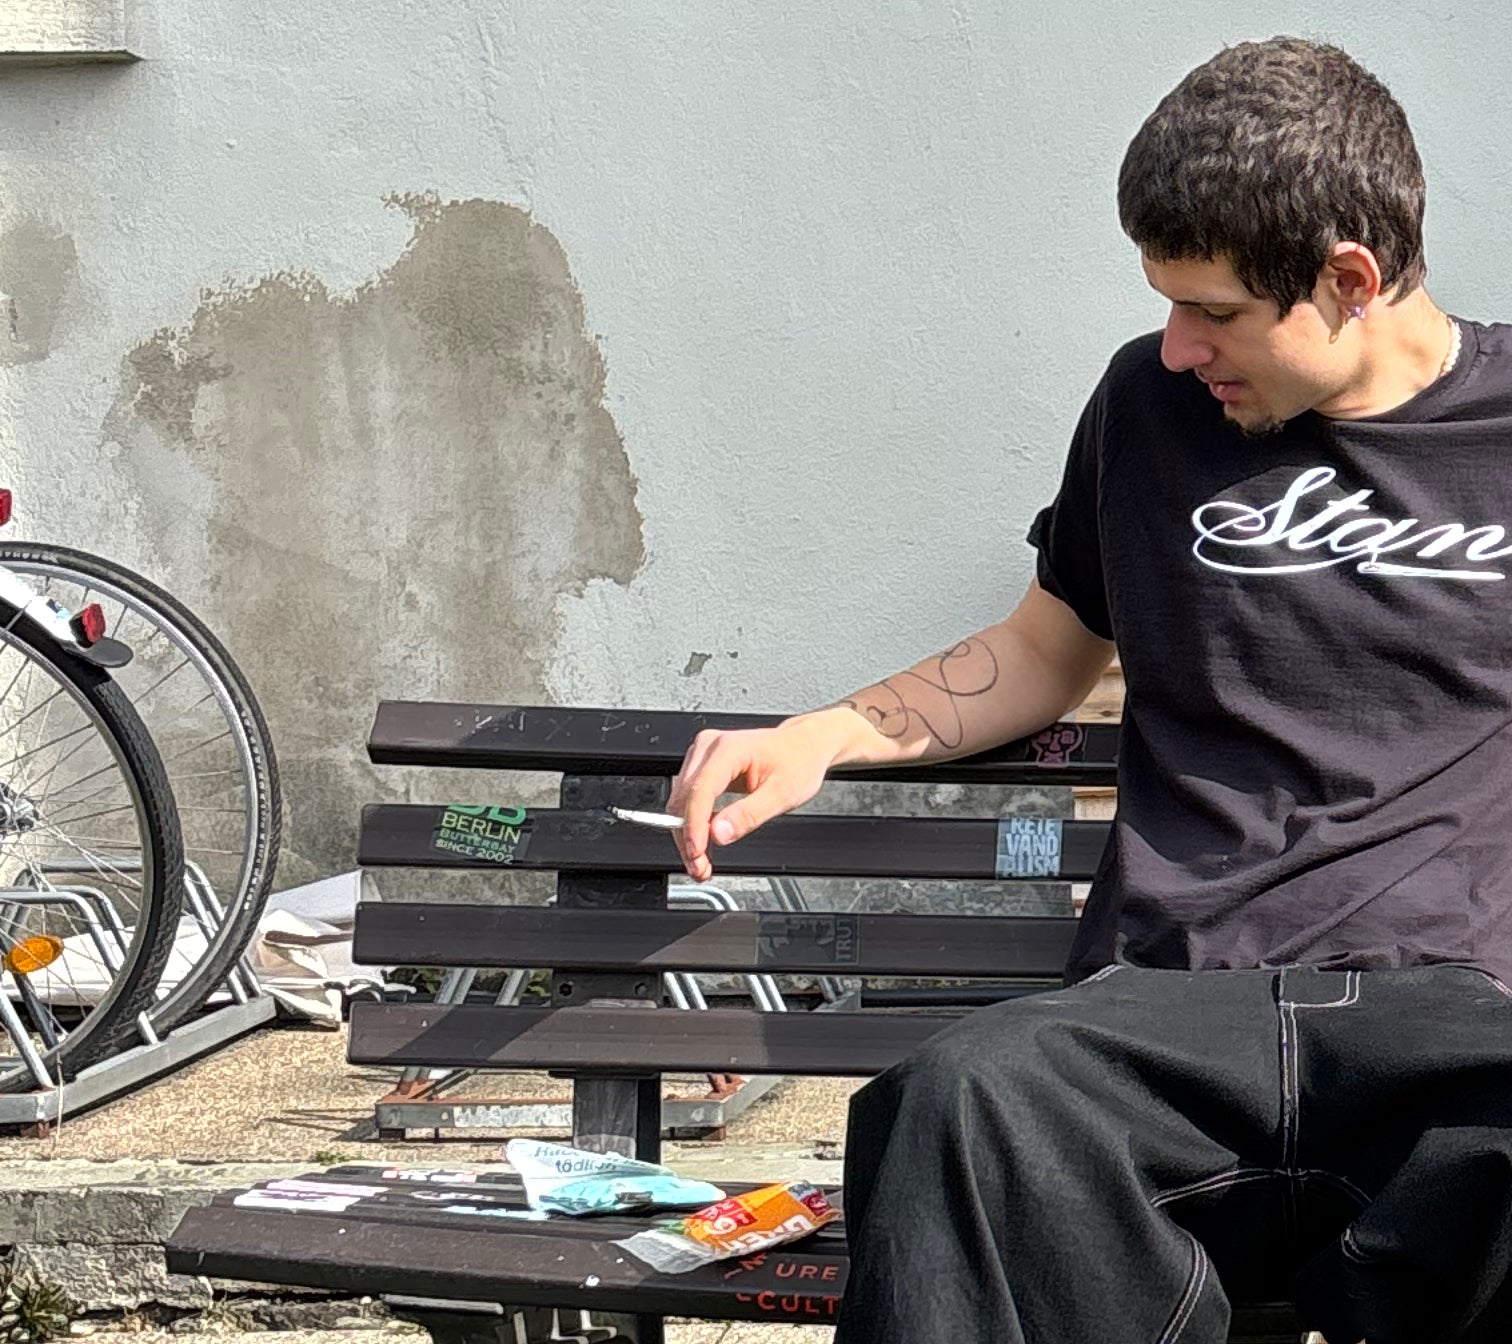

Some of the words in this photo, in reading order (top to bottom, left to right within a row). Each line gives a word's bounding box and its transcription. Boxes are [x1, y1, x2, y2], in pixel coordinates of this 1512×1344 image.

[441, 811, 521, 845] BERLIN
[435, 838, 477, 857] SINCE
[475, 847, 515, 866] 2002
[1005, 833, 1059, 856] VAND
